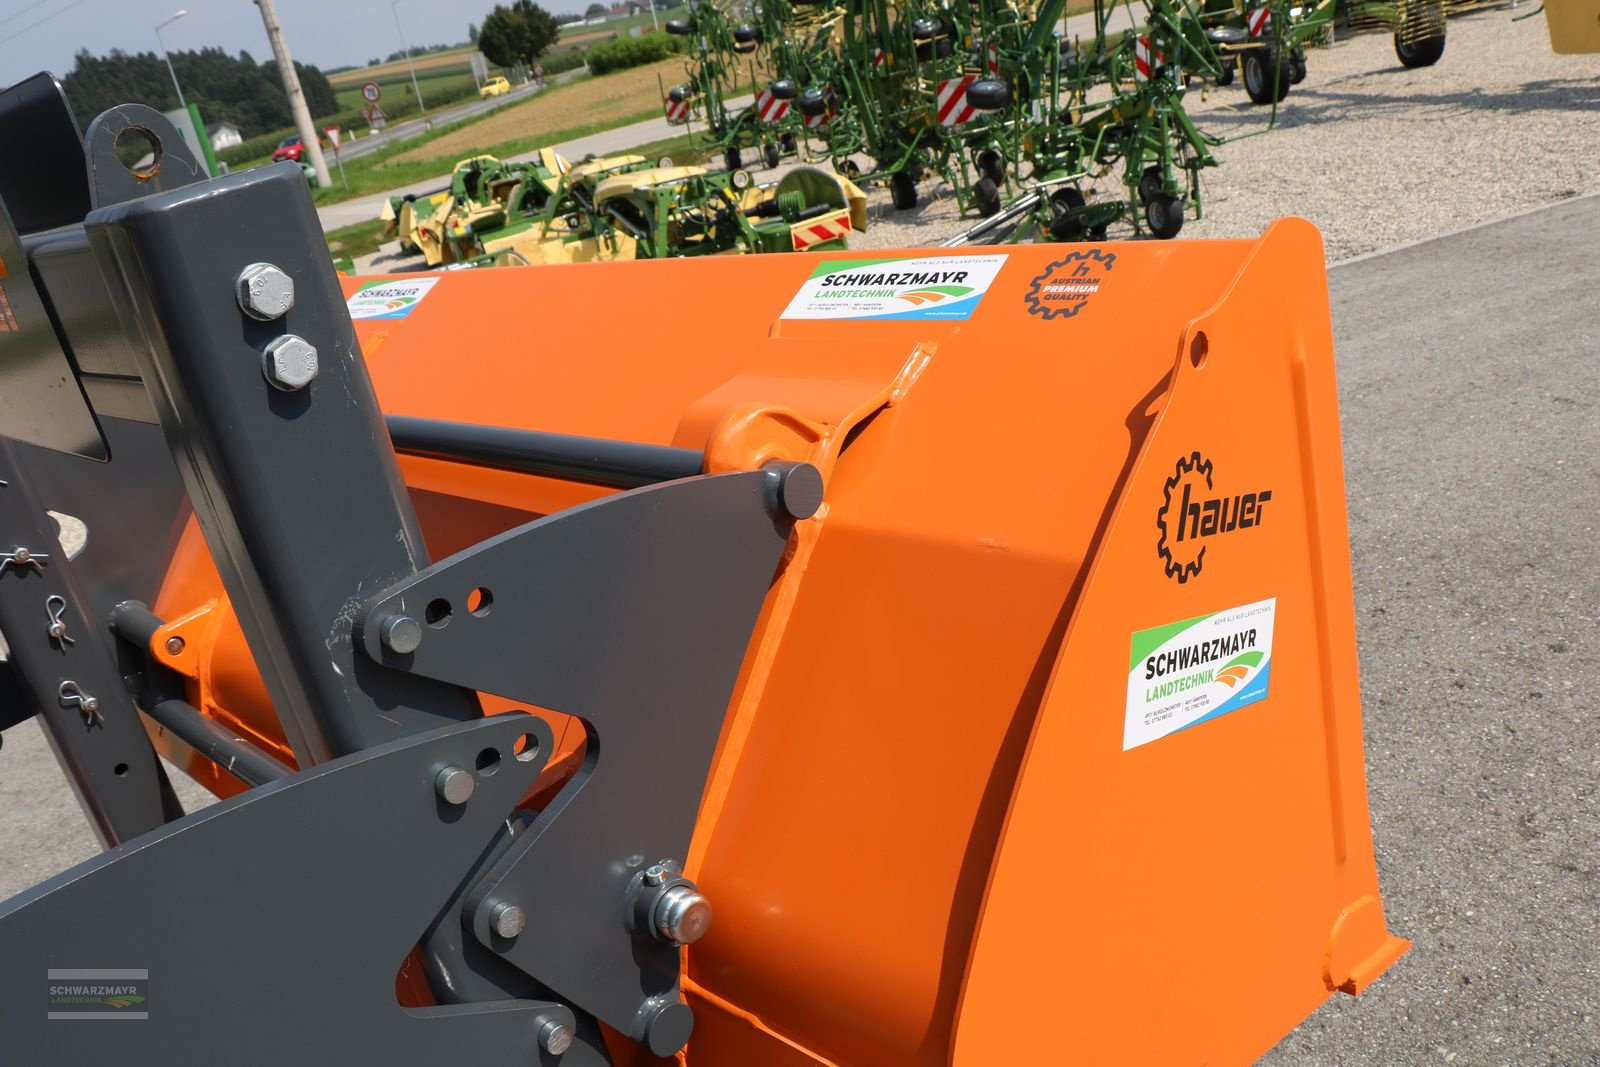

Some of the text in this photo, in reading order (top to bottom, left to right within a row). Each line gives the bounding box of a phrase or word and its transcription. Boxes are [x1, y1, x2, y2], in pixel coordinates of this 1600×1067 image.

[814, 288, 898, 298] LANDTECHNIK
[820, 270, 969, 287] SCHWARZMAYR
[1176, 483, 1272, 542] hauer
[1145, 628, 1257, 680] SCHWARZMAYR
[1146, 668, 1214, 703] LANDTECHNIK
